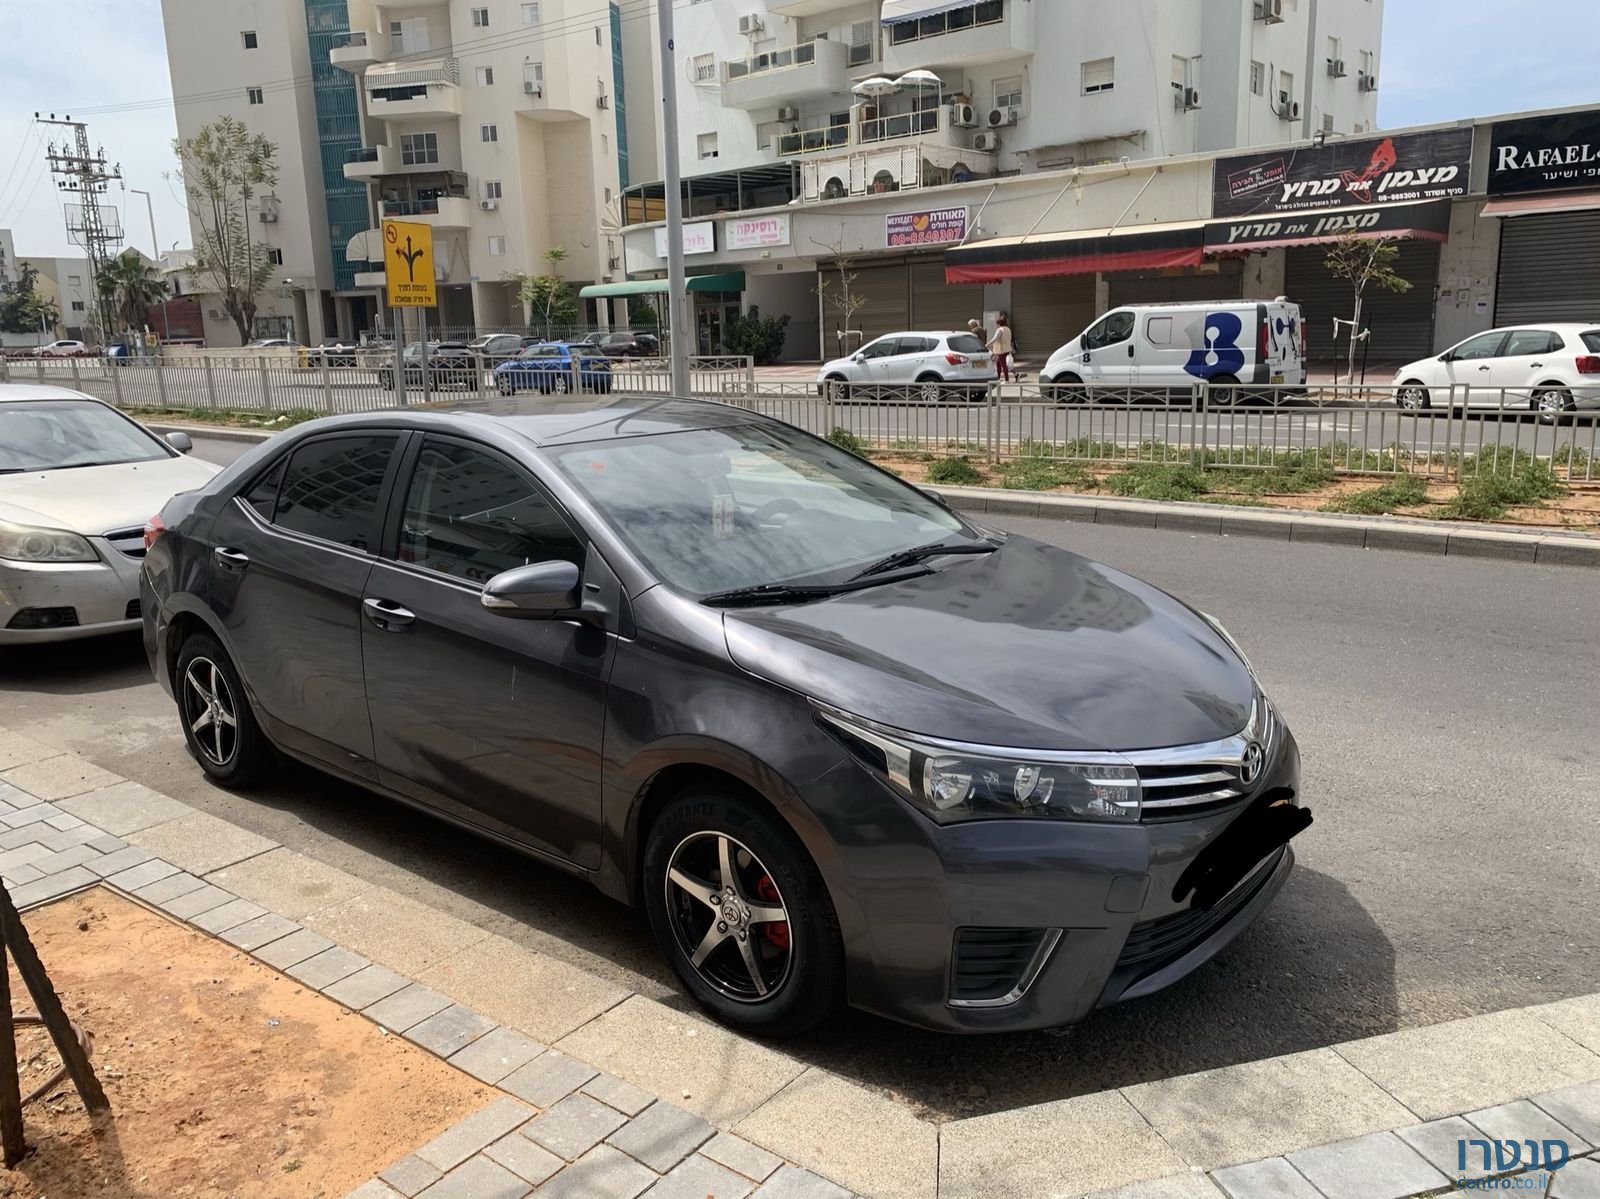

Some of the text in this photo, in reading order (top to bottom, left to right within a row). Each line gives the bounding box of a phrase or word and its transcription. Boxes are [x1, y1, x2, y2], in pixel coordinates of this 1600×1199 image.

[1496, 144, 1595, 172] RAFAEL
[1542, 169, 1578, 180] ושיער
[1280, 165, 1459, 203] מצמן את מרוץ
[1423, 190, 1446, 198] אשדוד
[1447, 187, 1464, 196] סניף
[930, 209, 965, 222] מאוחדת
[1227, 212, 1380, 243] מצמן את מרוץ
